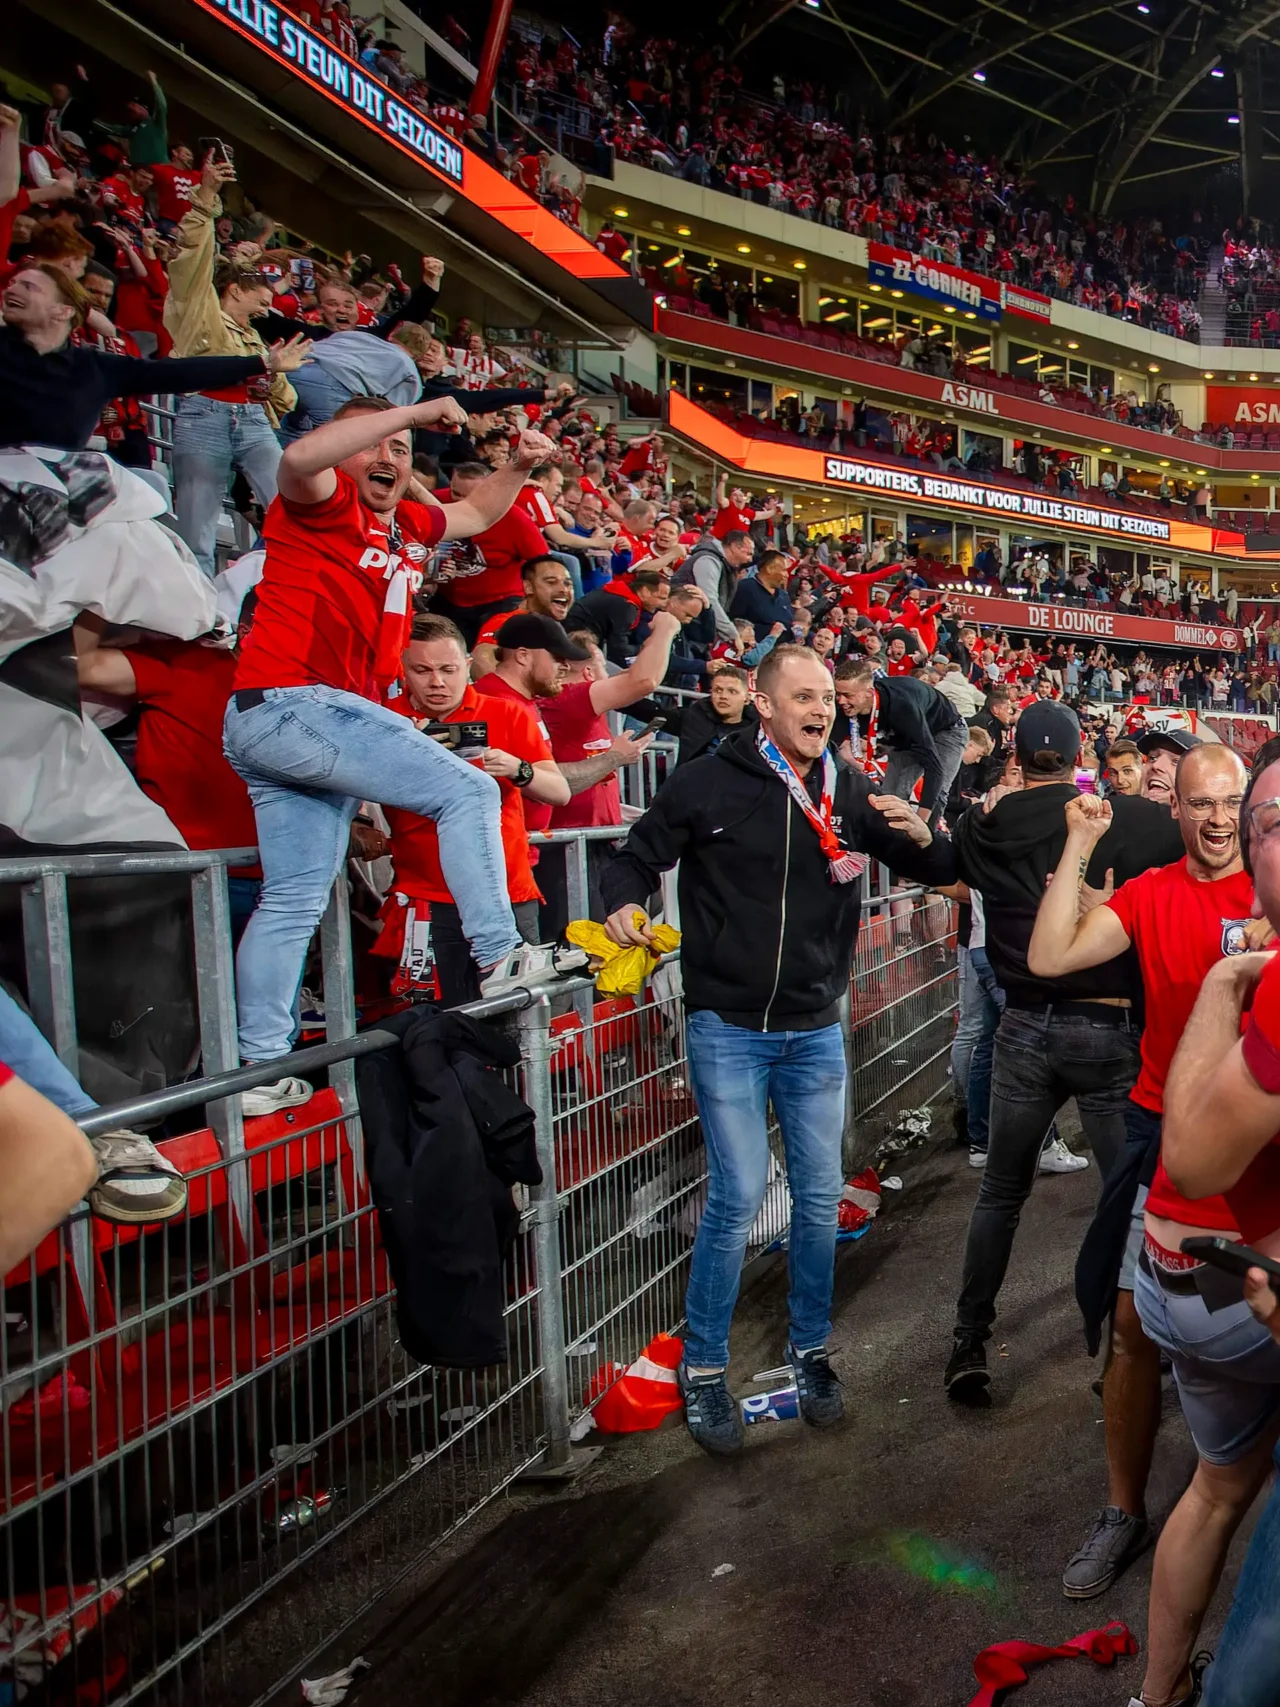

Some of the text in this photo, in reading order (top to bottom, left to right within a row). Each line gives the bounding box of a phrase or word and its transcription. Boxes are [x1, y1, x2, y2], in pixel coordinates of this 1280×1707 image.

[216, 0, 462, 180] LLIE STEUN DIT SEIZOEN!
[915, 264, 982, 307] CORNER
[941, 383, 999, 414] ASML
[826, 459, 1169, 538] SUPPORTERS, BEDANKT VOOR JULLIE STEUN DIT SEIZOEN!
[1028, 606, 1114, 635] DE LOUNGE
[1174, 624, 1207, 645] DOMMEL
[1151, 719, 1170, 732] SV
